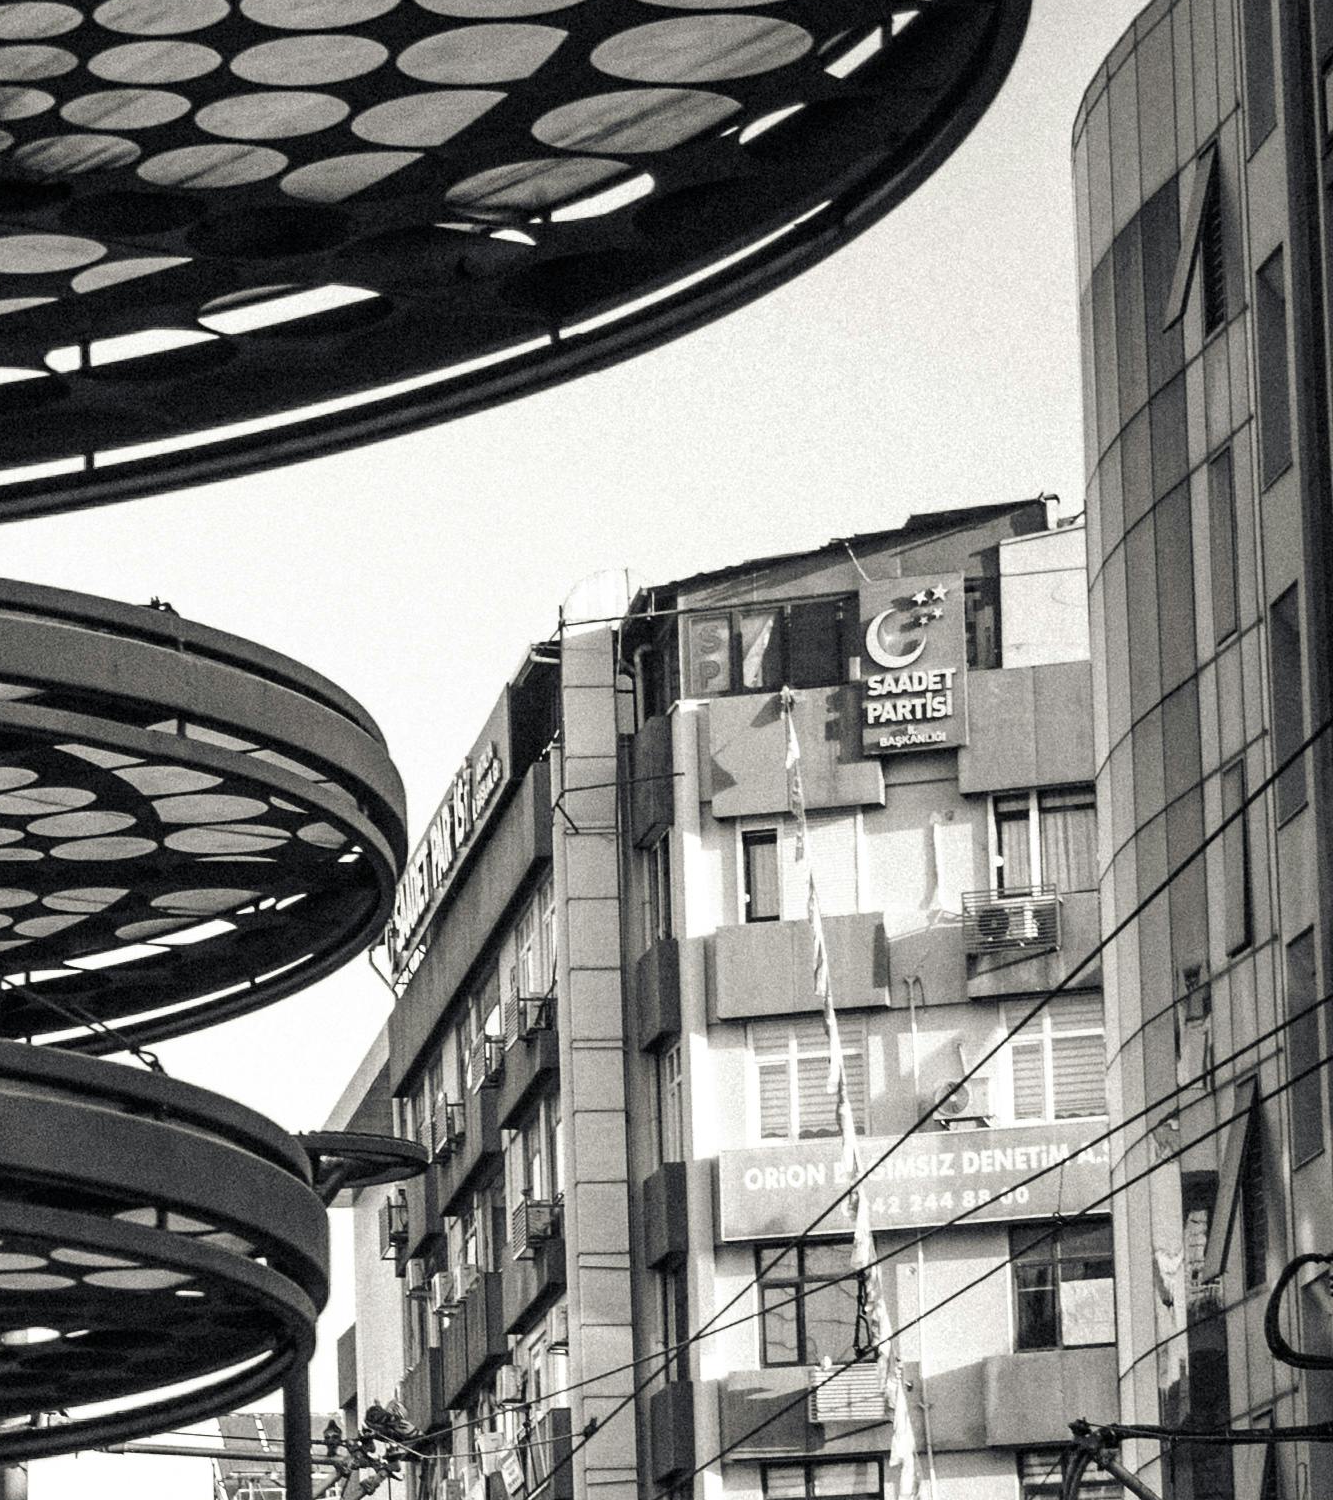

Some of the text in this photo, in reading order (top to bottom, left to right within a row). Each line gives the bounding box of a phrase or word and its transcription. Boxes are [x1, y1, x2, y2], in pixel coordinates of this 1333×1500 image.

[867, 668, 956, 697] SAADET
[867, 691, 953, 724] PARTİSİ
[745, 1162, 826, 1190] ORİON
[962, 1142, 1067, 1175] DENETİM
[910, 1191, 954, 1211] 244
